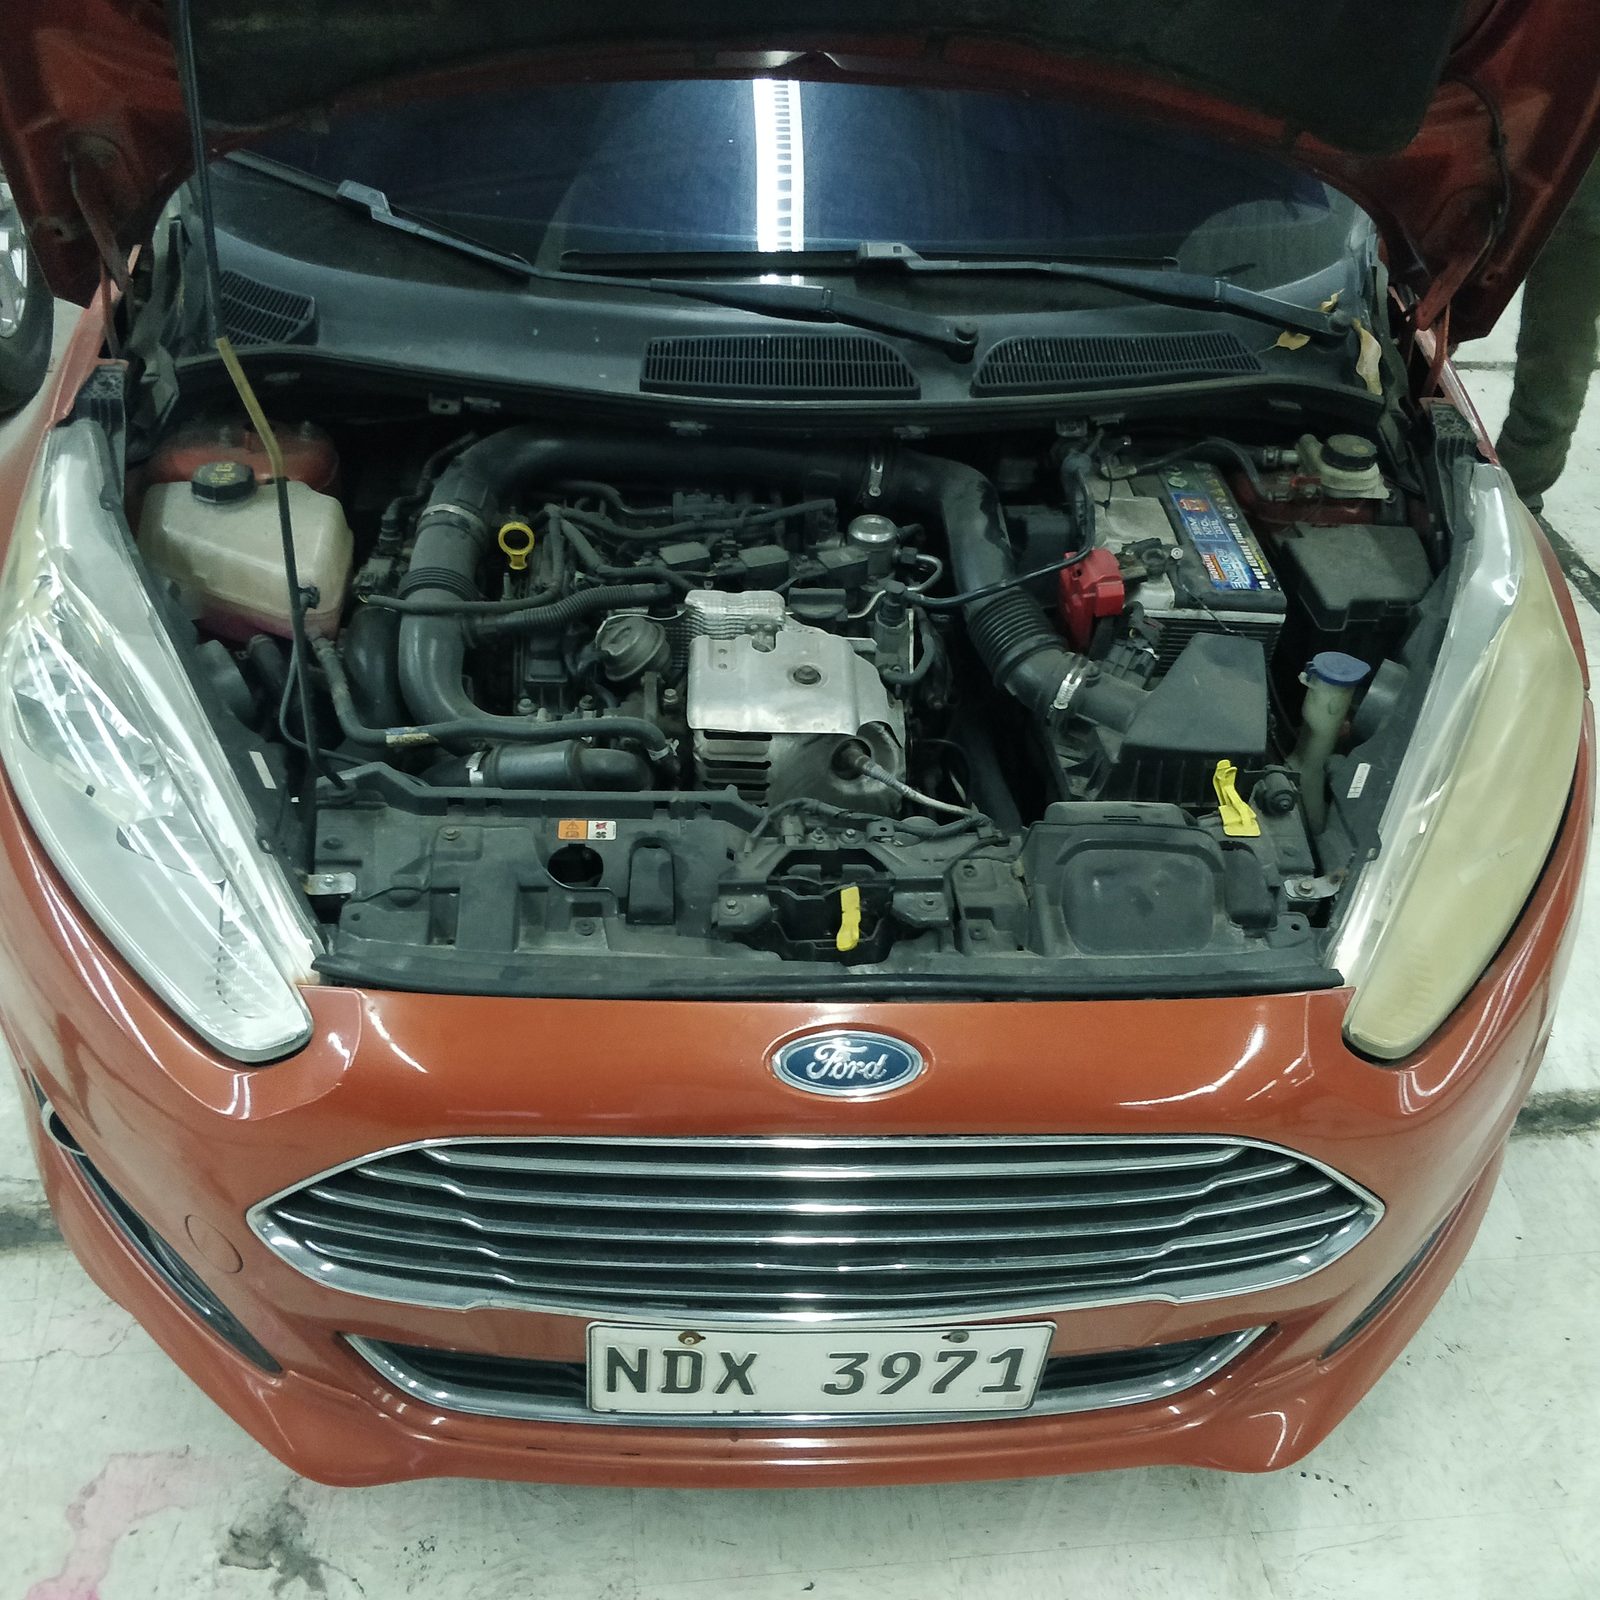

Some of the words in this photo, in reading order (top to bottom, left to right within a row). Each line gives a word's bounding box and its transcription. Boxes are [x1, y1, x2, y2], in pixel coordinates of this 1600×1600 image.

[806, 1037, 888, 1080] Ford
[605, 1346, 757, 1395] NDX
[821, 1348, 1026, 1396] 3971
